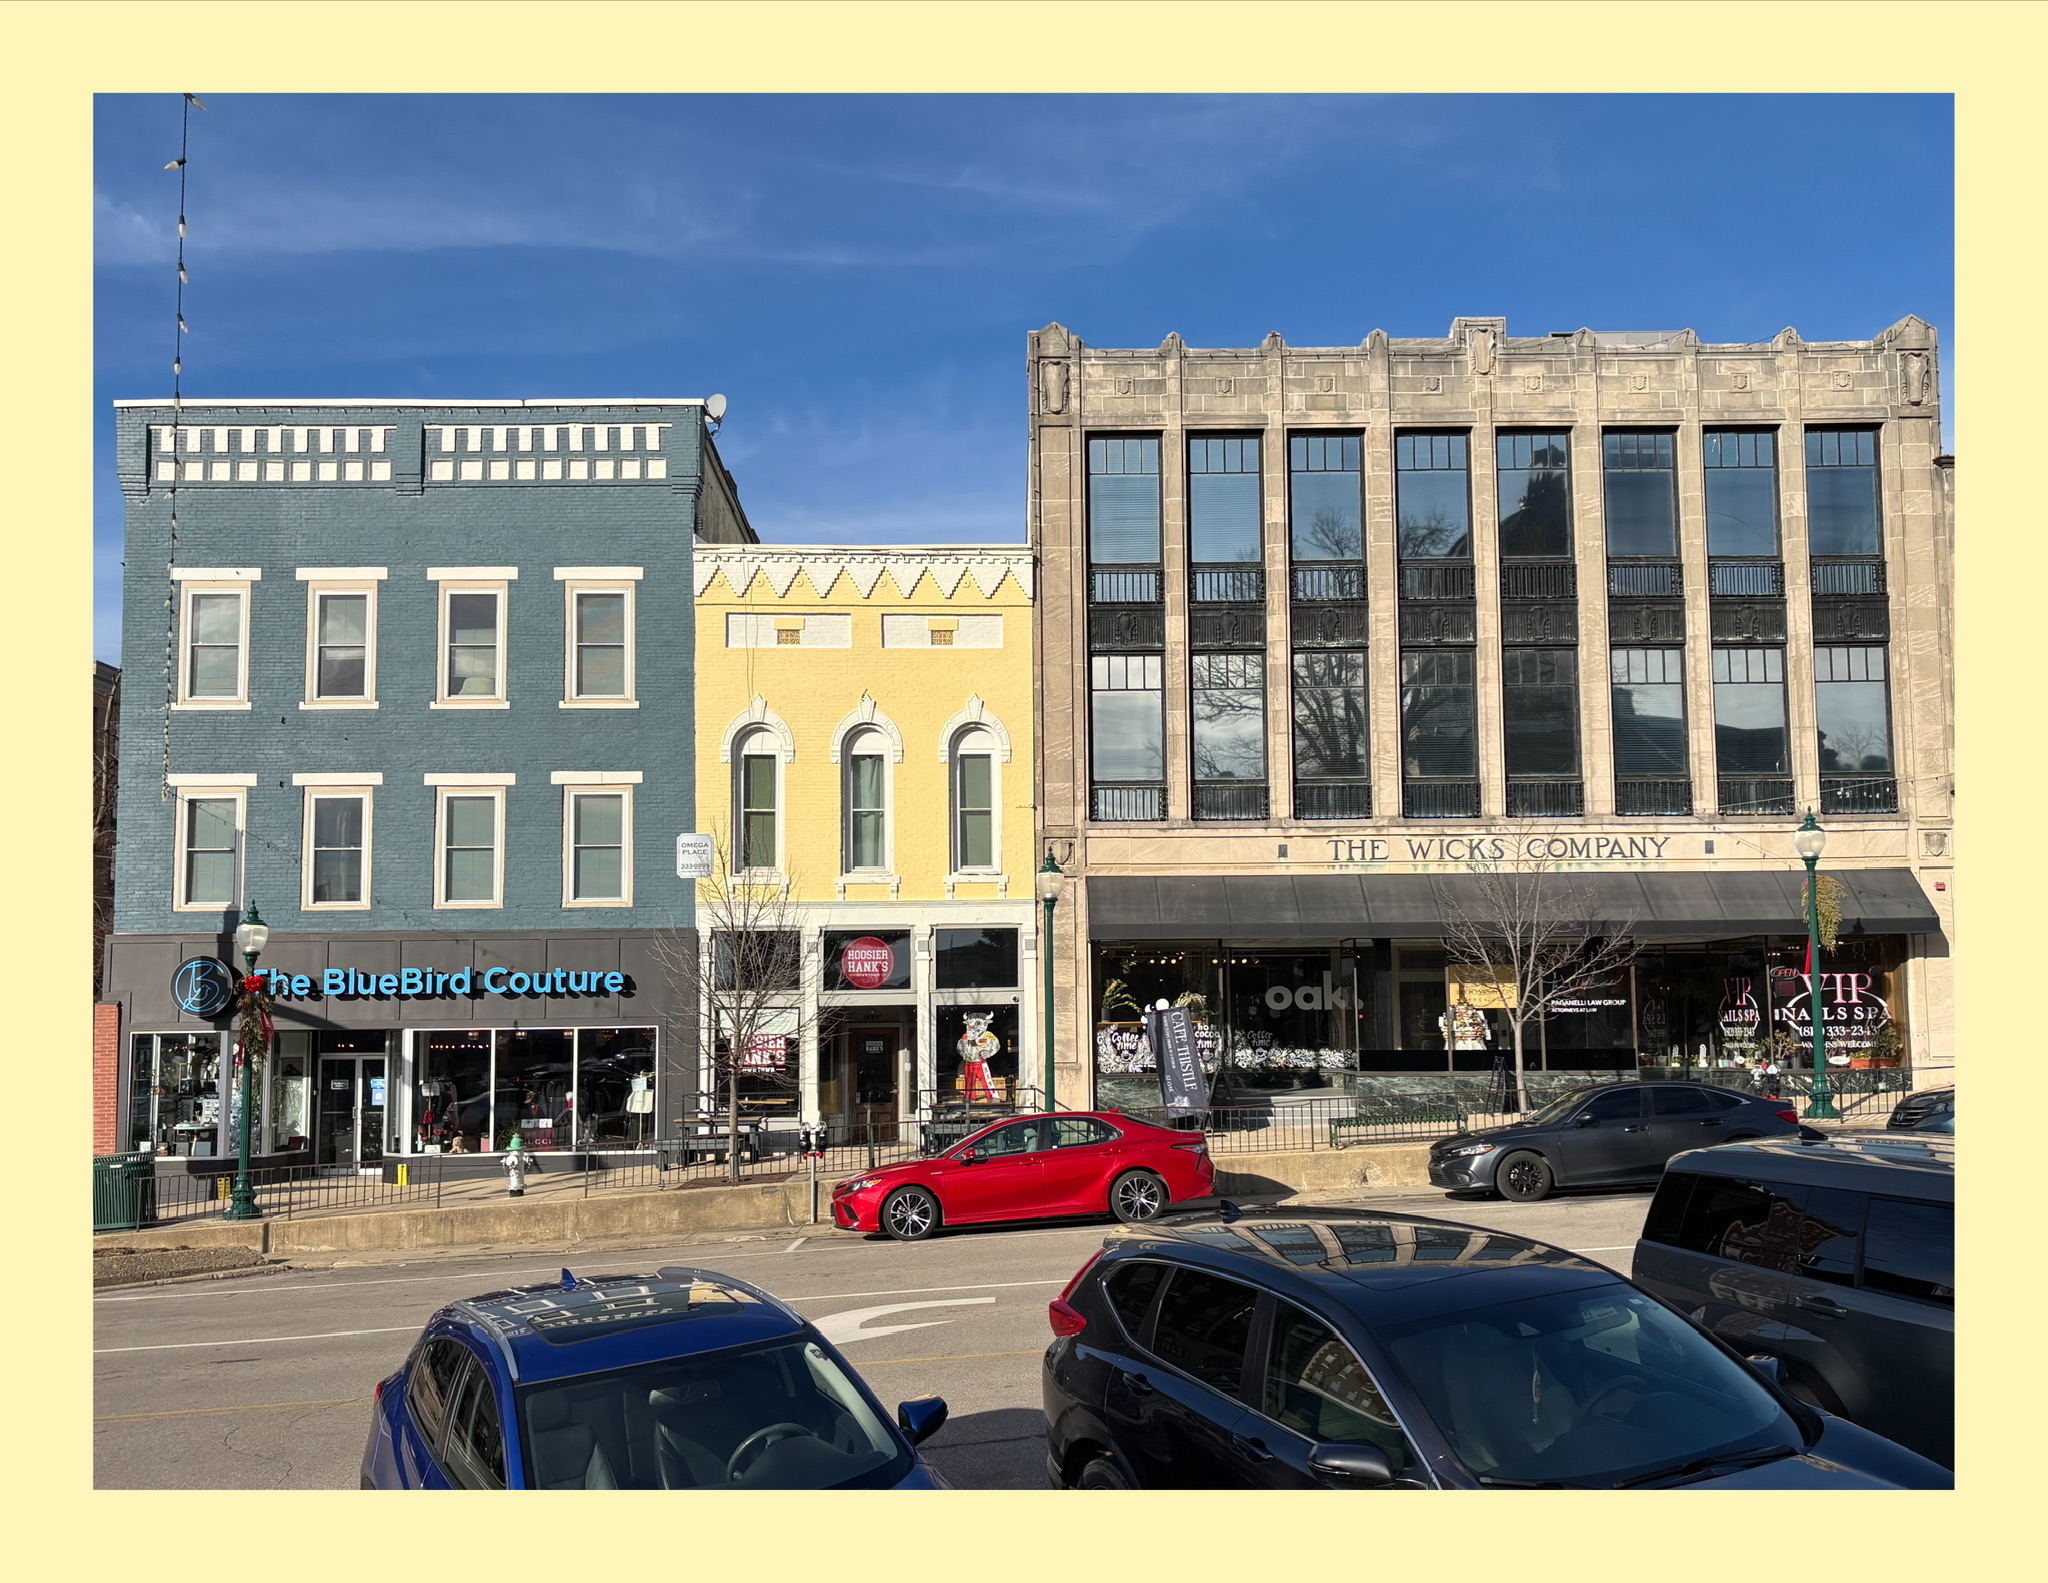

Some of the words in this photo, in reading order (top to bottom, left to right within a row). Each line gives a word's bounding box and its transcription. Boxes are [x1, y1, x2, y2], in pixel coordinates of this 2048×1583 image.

[1326, 839, 1389, 861] THE
[1405, 838, 1505, 861] WICKS
[1526, 836, 1671, 860] COMPANY
[847, 949, 889, 960] HOOSIER
[847, 961, 889, 973] HANK'S
[1772, 967, 1798, 978] OPEN
[323, 967, 472, 995] BlueBird
[483, 966, 625, 994] Couture
[1724, 976, 1752, 1006] VIP
[1799, 972, 1874, 1004] VIP
[1718, 1009, 1743, 1022] NAILS
[1744, 1009, 1761, 1022] SPA
[1781, 1006, 1848, 1021] NALS
[1853, 1006, 1893, 1020] SPA
[1799, 1025, 1825, 1037] (81)
[1826, 1025, 1879, 1037] 333-2343
[1801, 1041, 1838, 1049] WA-INS
[1177, 1045, 1198, 1092] THISTLE
